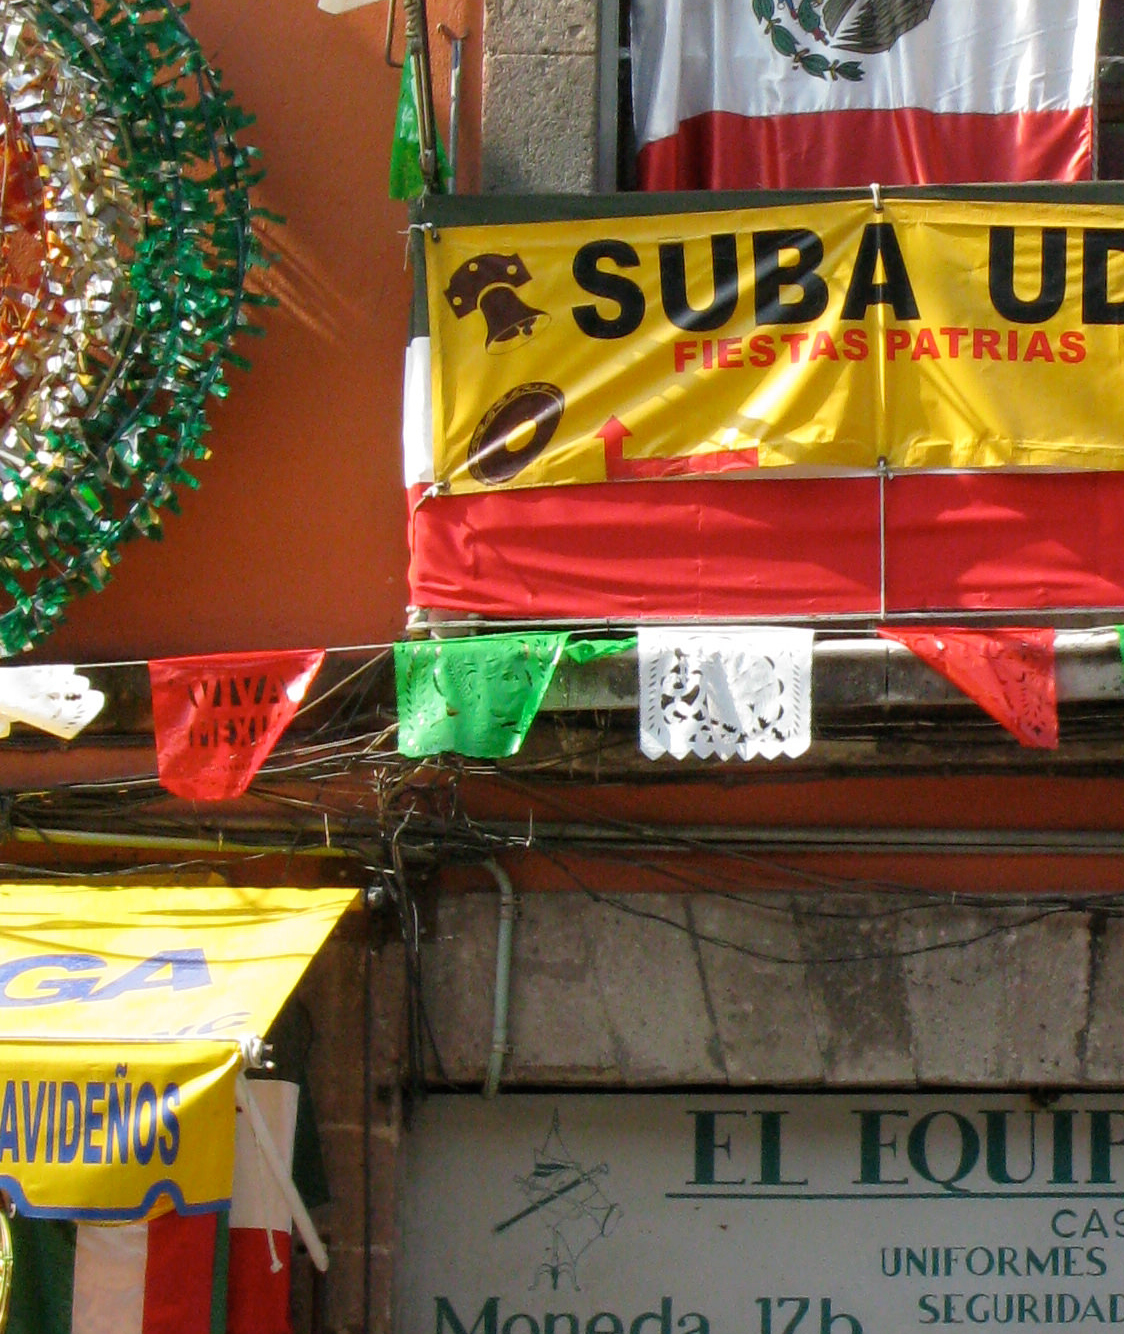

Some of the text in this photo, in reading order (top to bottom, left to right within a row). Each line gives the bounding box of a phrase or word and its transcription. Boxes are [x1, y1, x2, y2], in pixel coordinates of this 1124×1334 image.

[571, 224, 919, 340] SUBA
[673, 326, 1088, 374] FIESTAS PATRIAS
[187, 674, 290, 709] VIVA
[686, 1110, 808, 1186] EL
[881, 1246, 1107, 1278] UNIFORMES
